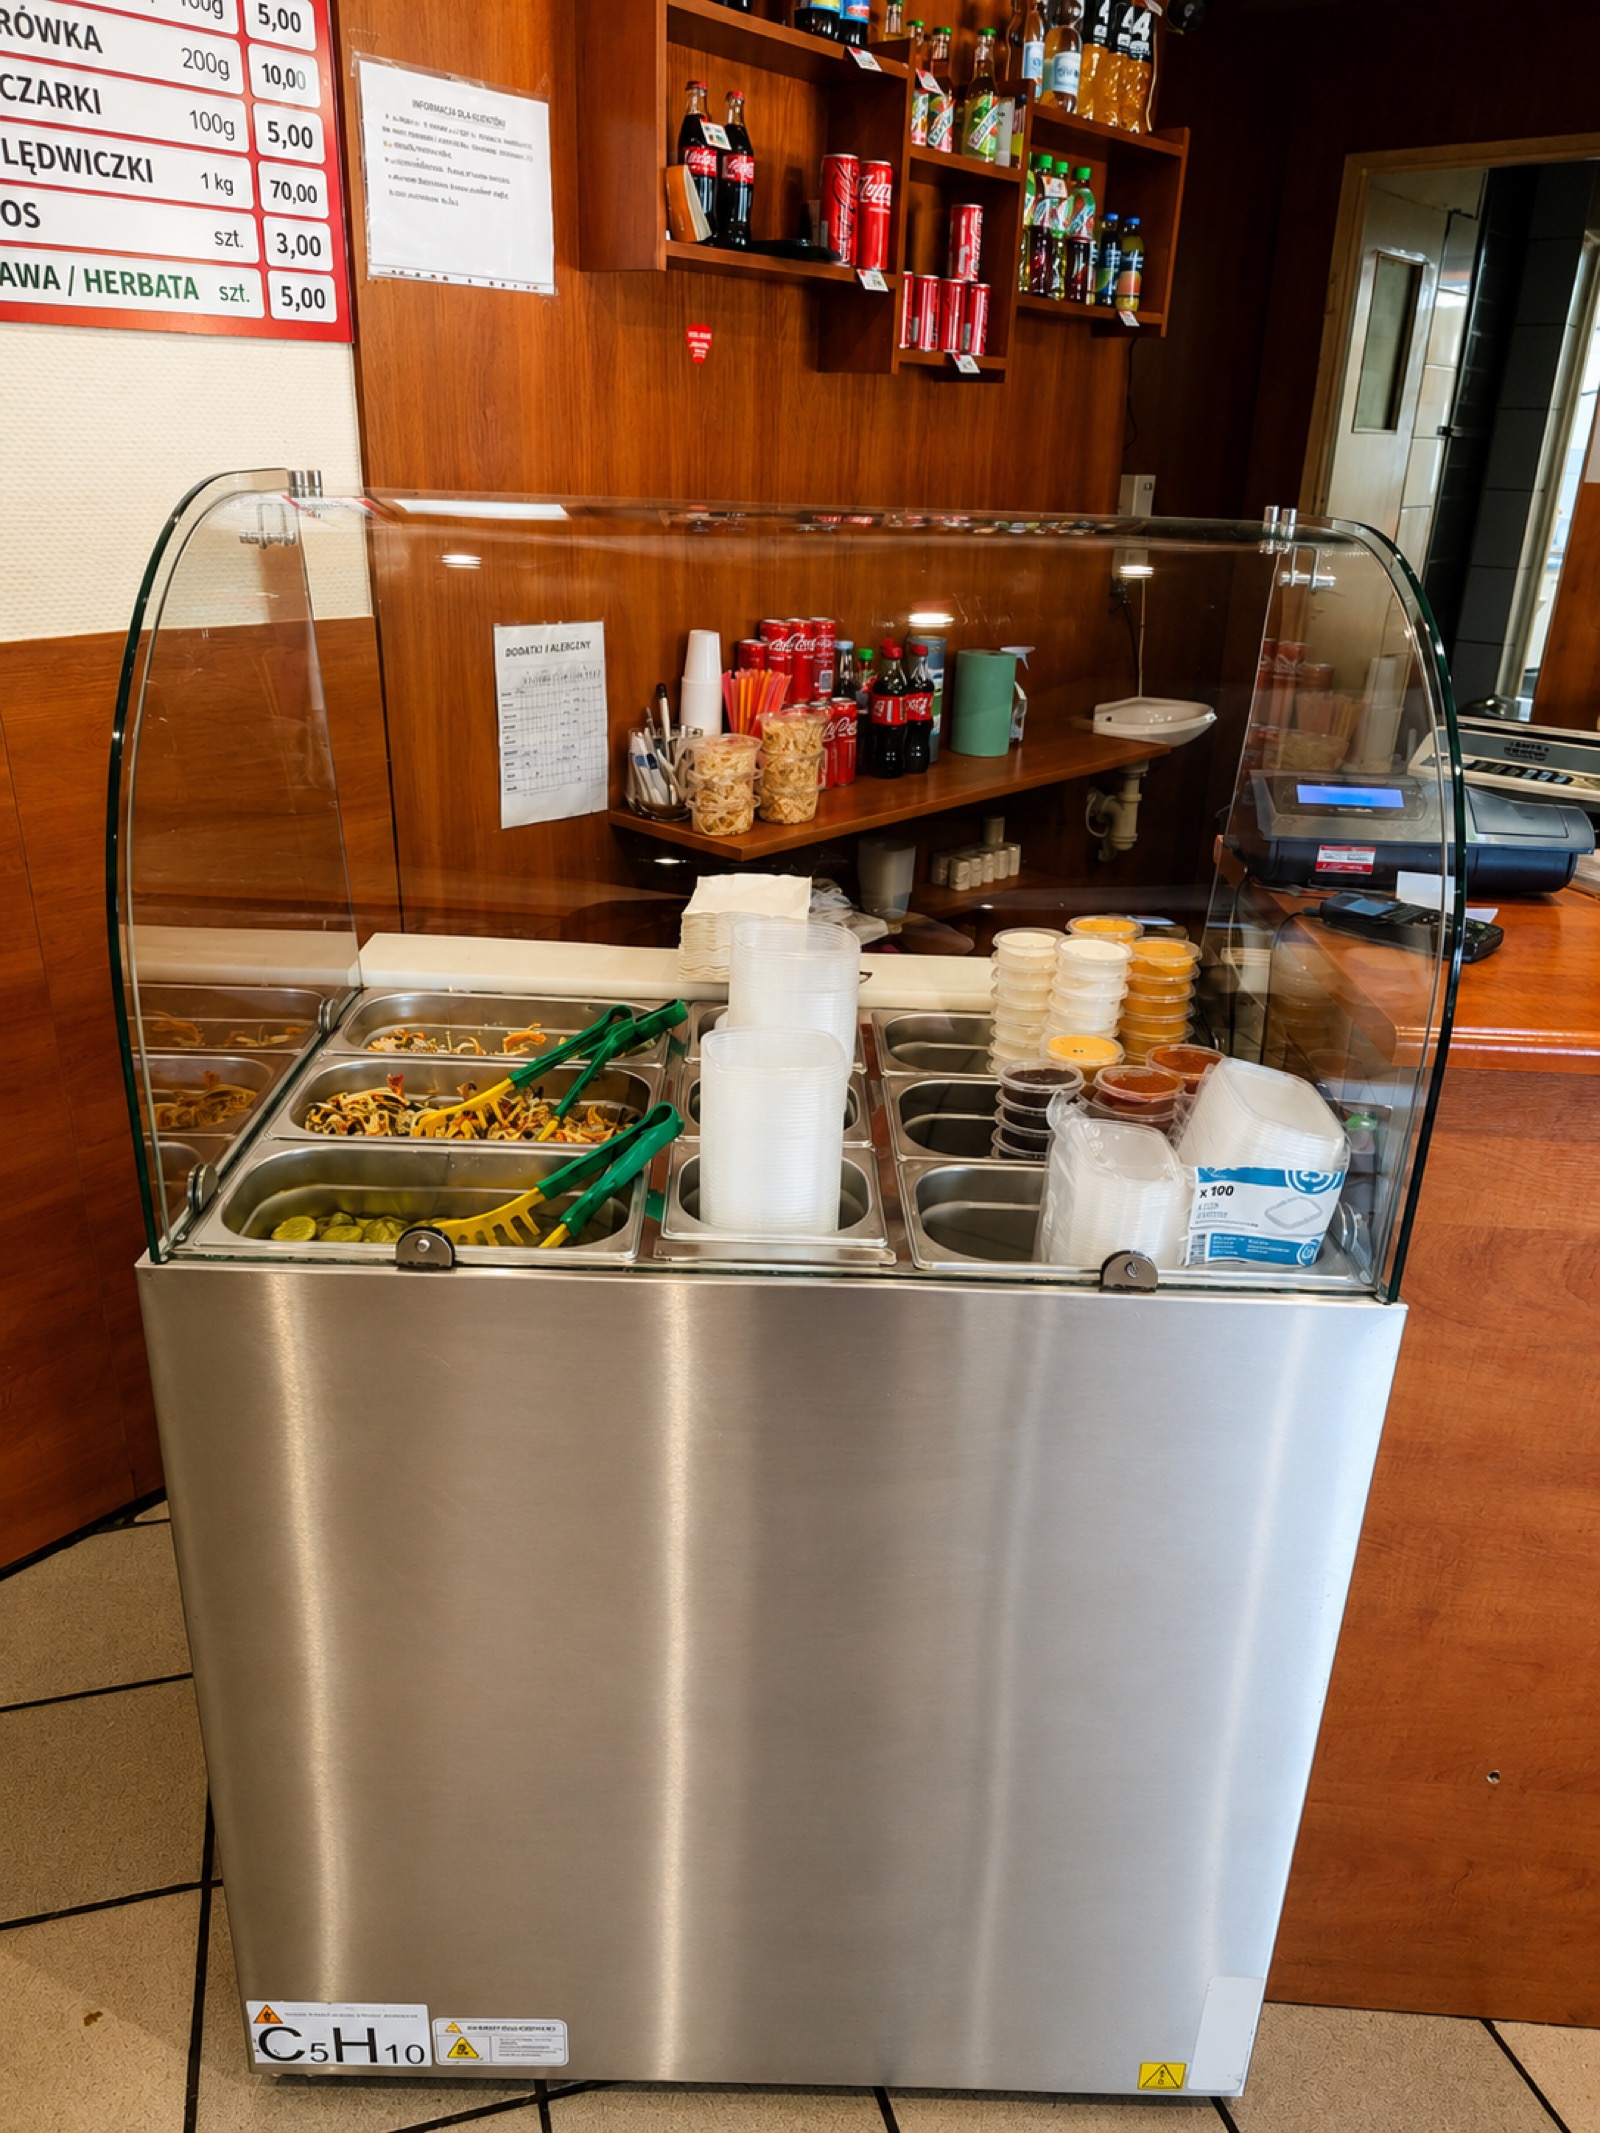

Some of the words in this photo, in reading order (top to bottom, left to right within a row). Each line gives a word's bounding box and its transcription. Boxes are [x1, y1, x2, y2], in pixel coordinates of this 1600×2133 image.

[180, 0, 223, 19] 0g
[258, 3, 301, 33] 5,00
[0, 4, 103, 54] RÓWKA
[181, 48, 230, 80] 200g
[261, 63, 306, 91] 10,00
[0, 73, 102, 115] CZARKI
[189, 110, 235, 141] 100g
[267, 121, 313, 149] 5,00
[1, 137, 154, 184] LĘDWICZKI
[200, 173, 209, 190] 1
[214, 174, 234, 196] kg
[270, 180, 317, 204] 70,00
[1, 199, 41, 229] OS
[214, 230, 244, 248] szt.
[276, 232, 321, 258] 3,00
[0, 261, 61, 290] AWA
[67, 265, 75, 297] /
[83, 267, 200, 300] HERBATA
[219, 283, 250, 303] szt.
[281, 286, 326, 312] 5,00
[1200, 1190, 1208, 1199] x
[1210, 1185, 1234, 1198] 100
